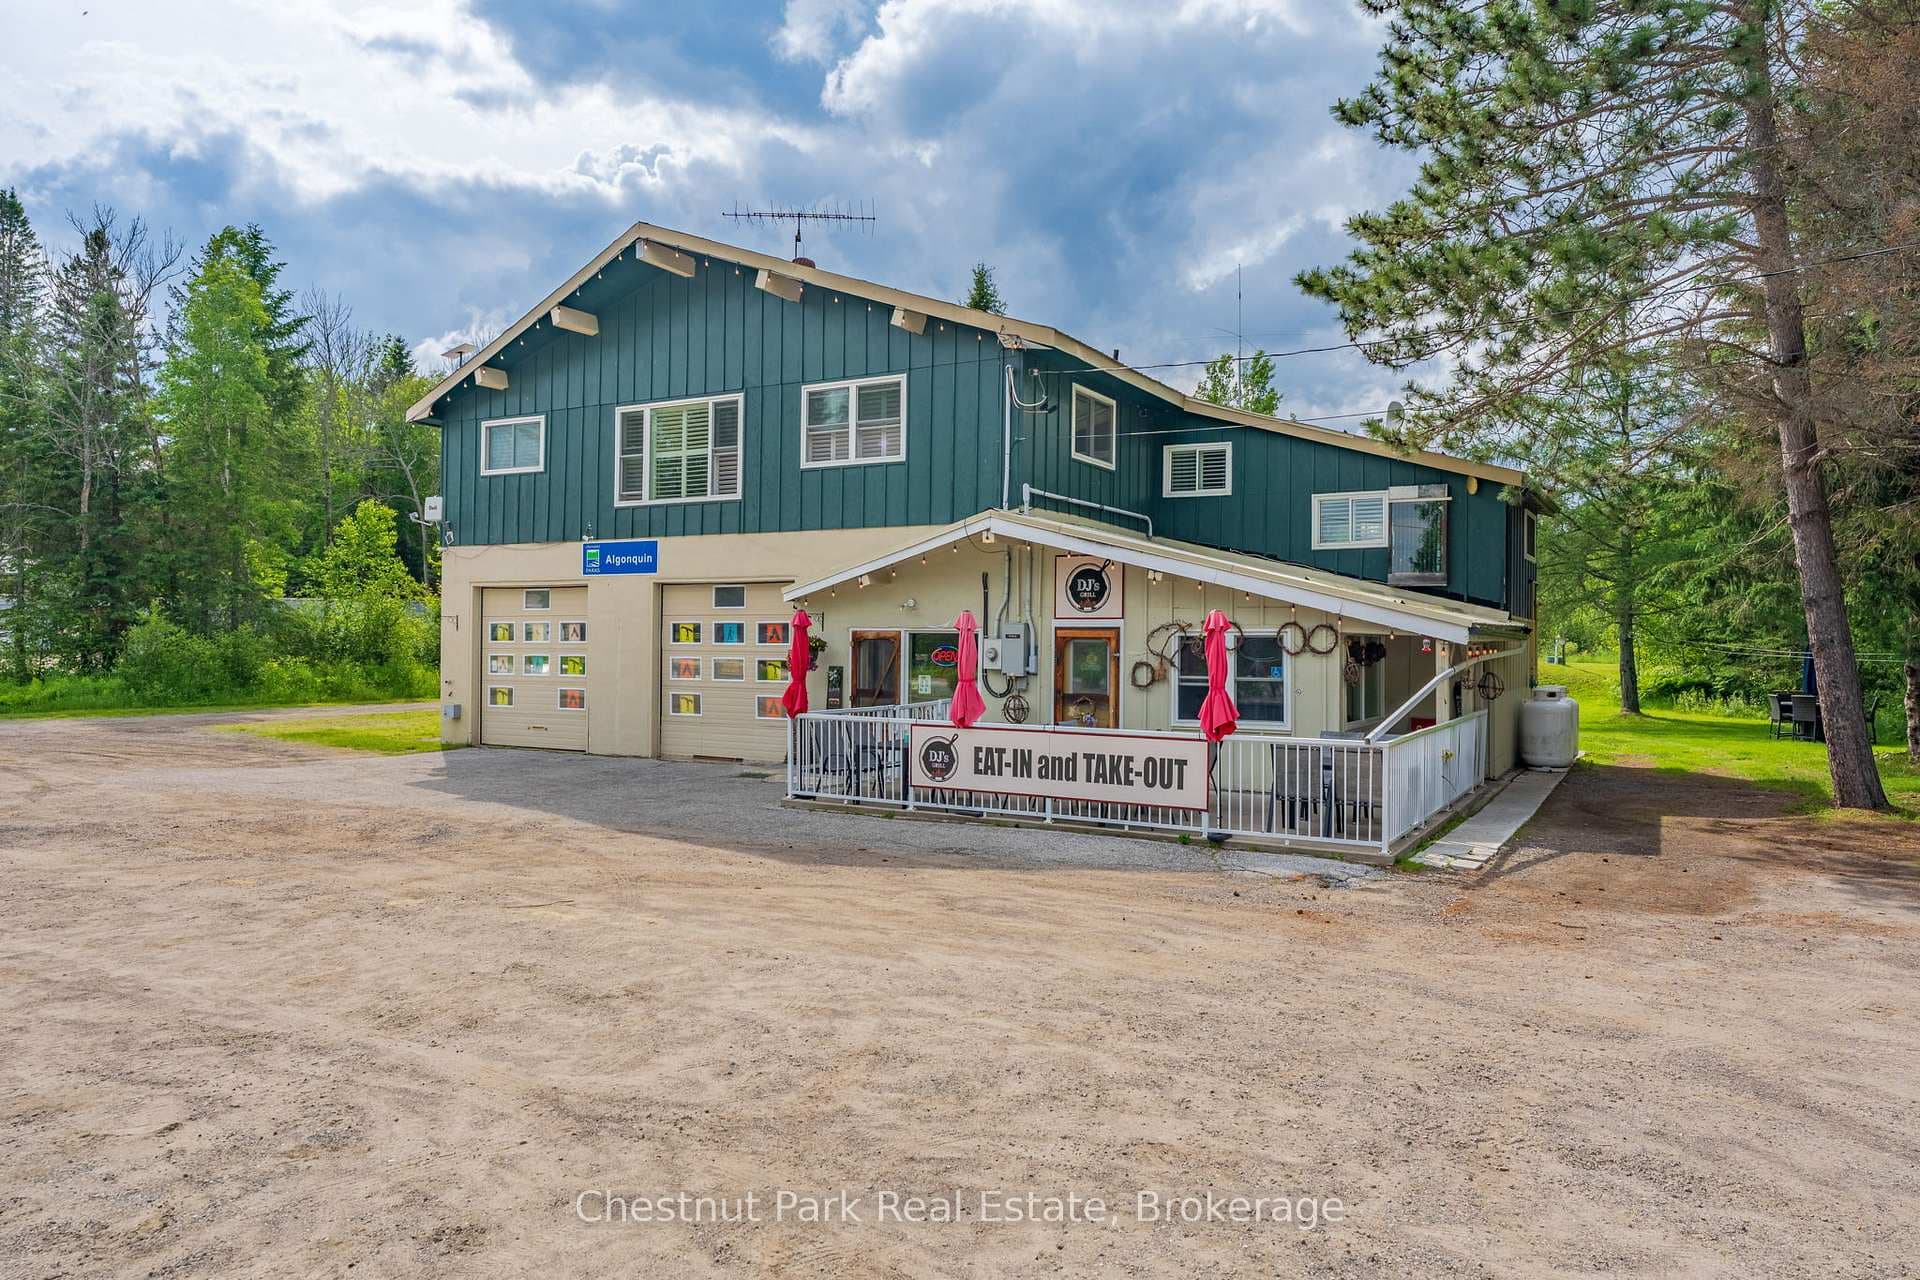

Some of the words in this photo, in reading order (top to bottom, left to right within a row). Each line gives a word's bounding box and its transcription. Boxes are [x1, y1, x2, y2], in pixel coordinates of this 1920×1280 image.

[605, 553, 653, 566] Algonquin
[1077, 579, 1101, 591] DJ's
[929, 750, 950, 763] DJ's
[973, 746, 1032, 779] EAT-IN
[1037, 752, 1078, 782] and
[1082, 753, 1188, 791] TAKE-OUT
